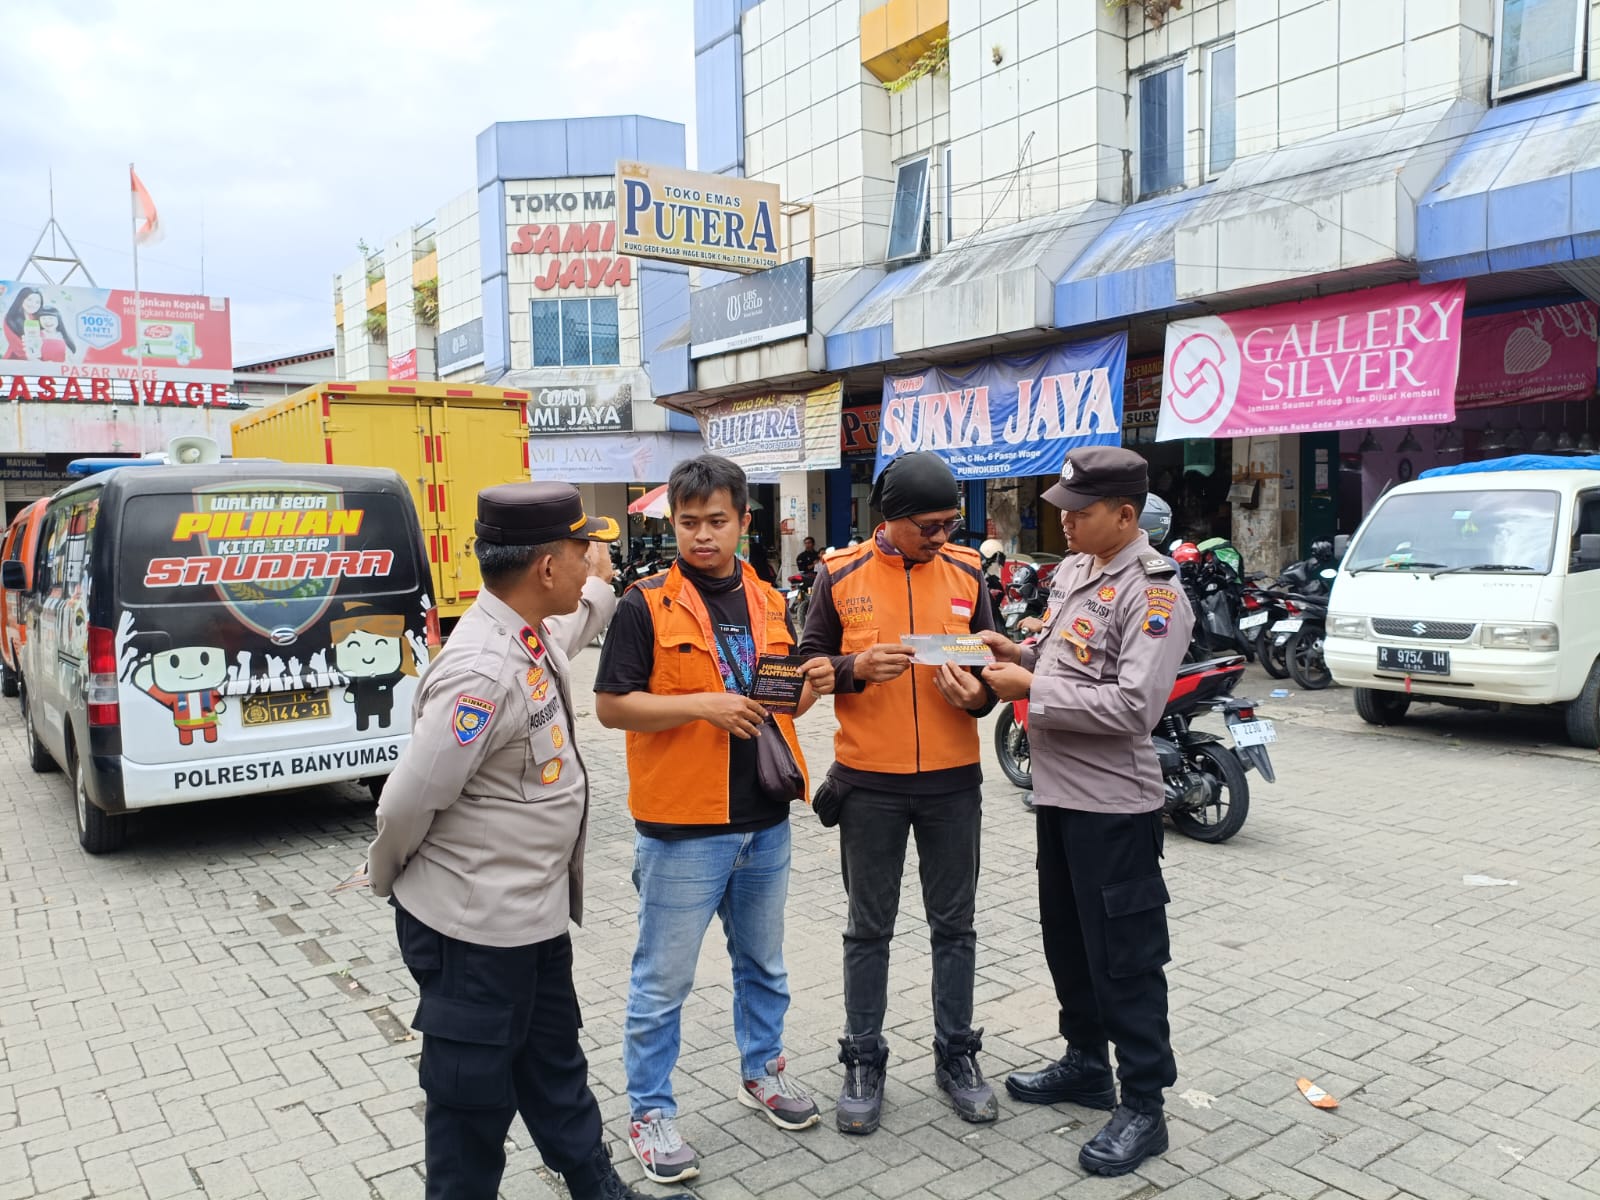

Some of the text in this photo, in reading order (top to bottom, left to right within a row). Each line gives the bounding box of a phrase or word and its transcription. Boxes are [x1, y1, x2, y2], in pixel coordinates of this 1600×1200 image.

[510, 191, 615, 213] TOKO MA
[664, 186, 741, 208] TOKO EMAS
[623, 179, 778, 253] PUTERA
[511, 220, 615, 255] SAMI
[661, 247, 681, 255] PASAR
[683, 250, 699, 258] WAGE
[534, 257, 631, 291] JAYA
[743, 289, 757, 301] UBS
[173, 300, 206, 311] Kepala
[743, 298, 763, 311] GOLD
[80, 315, 114, 328] 100%
[1242, 297, 1462, 365] GALLERY
[61, 365, 158, 381] PASAR WAGE
[1262, 348, 1427, 401] SILVER
[0, 374, 230, 407] ASAR WAGE
[894, 376, 924, 394] TOKO
[1401, 388, 1440, 398] Kembali
[1546, 382, 1586, 393] kembali
[567, 406, 621, 425] JAYA
[881, 386, 993, 456] SURYA
[1003, 366, 1120, 445] JAYA
[1126, 410, 1159, 423] SURY
[708, 405, 800, 449] PUTERA
[562, 447, 602, 464] JAYA
[967, 454, 973, 462] C
[994, 452, 1017, 461] Pasar
[1018, 450, 1040, 459] Wage
[957, 464, 1010, 475] PURWOKERTO
[211, 495, 275, 511] WALAU
[172, 509, 365, 541] PILIHAN
[217, 540, 266, 555] KITA
[143, 549, 394, 588] SAUDARA
[846, 595, 872, 606] PUTRA
[1083, 599, 1111, 618] POLISI
[842, 613, 873, 624] CREW
[1381, 648, 1388, 661] R
[1397, 650, 1423, 664] 9754
[462, 697, 493, 711] BINMAS
[174, 744, 399, 790] POLRESTA BANYUMAS
